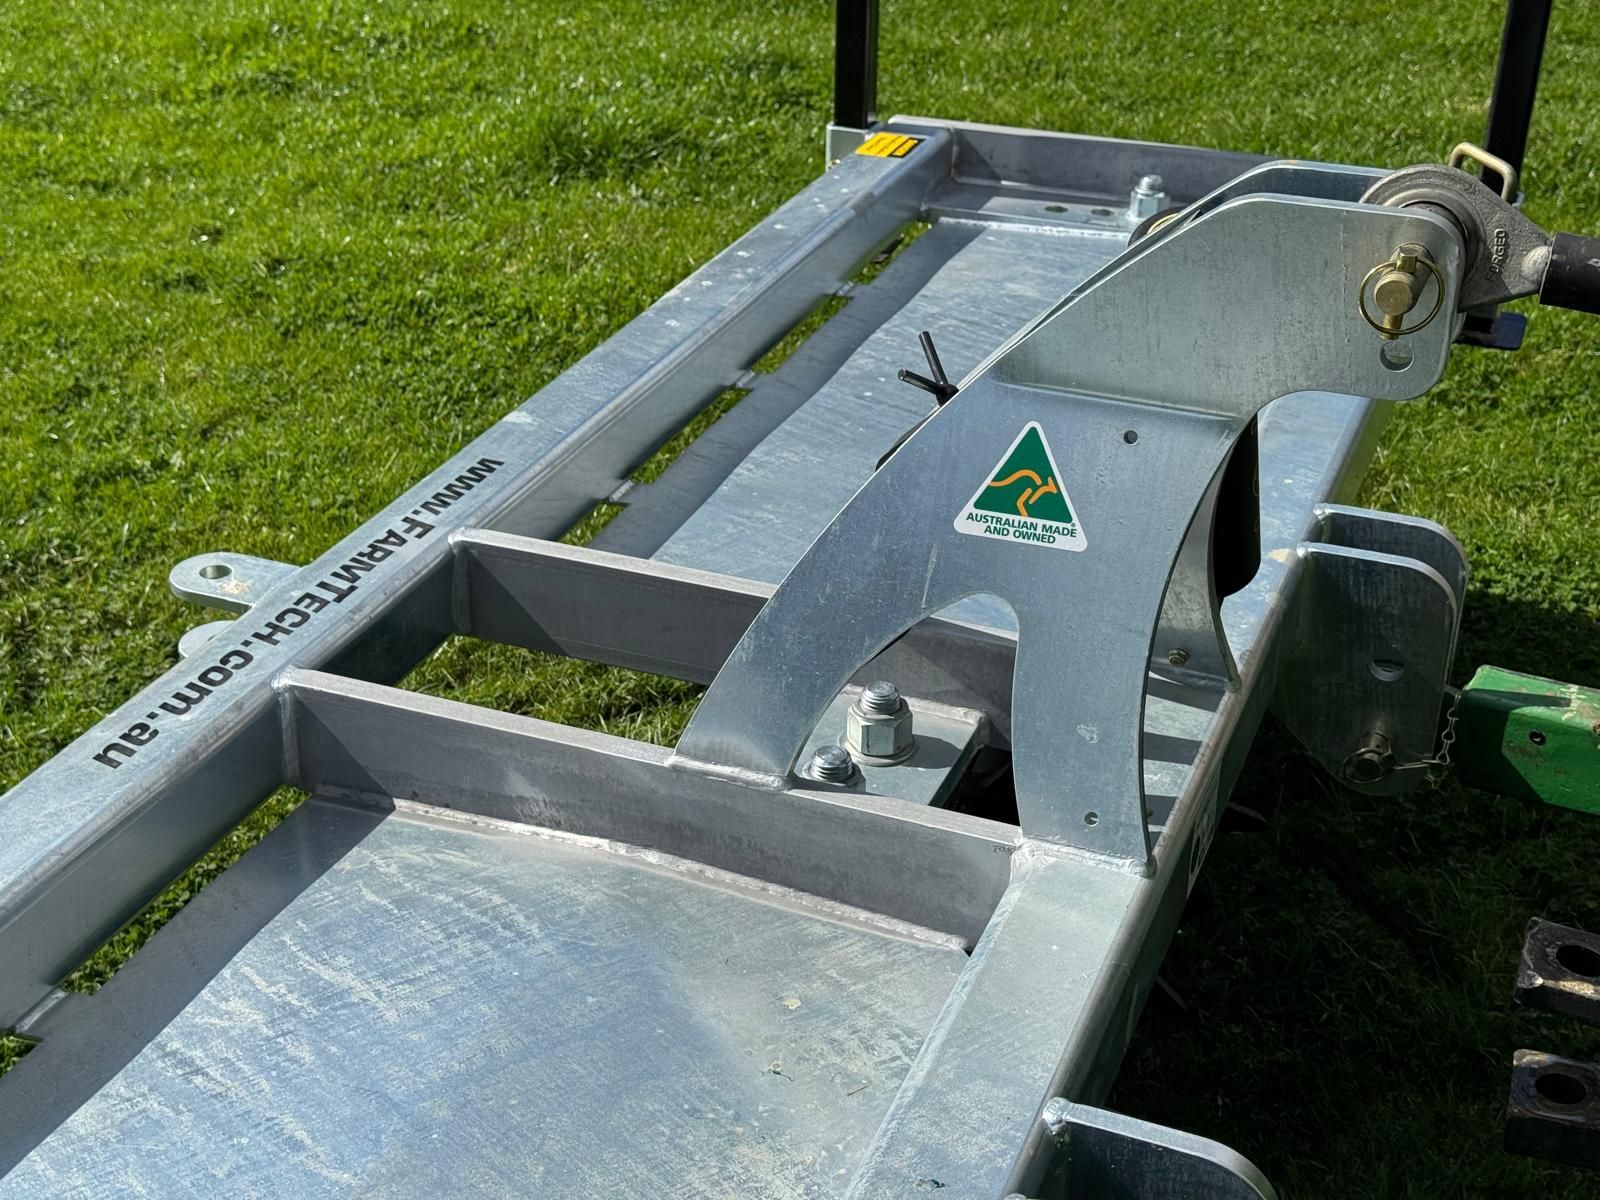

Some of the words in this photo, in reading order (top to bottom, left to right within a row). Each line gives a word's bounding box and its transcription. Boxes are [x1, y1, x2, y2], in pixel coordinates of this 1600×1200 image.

[966, 512, 1038, 531] AUSTRALIAN
[1041, 523, 1077, 538] MADE
[984, 525, 1010, 537] AND
[1012, 529, 1056, 544] OWNED
